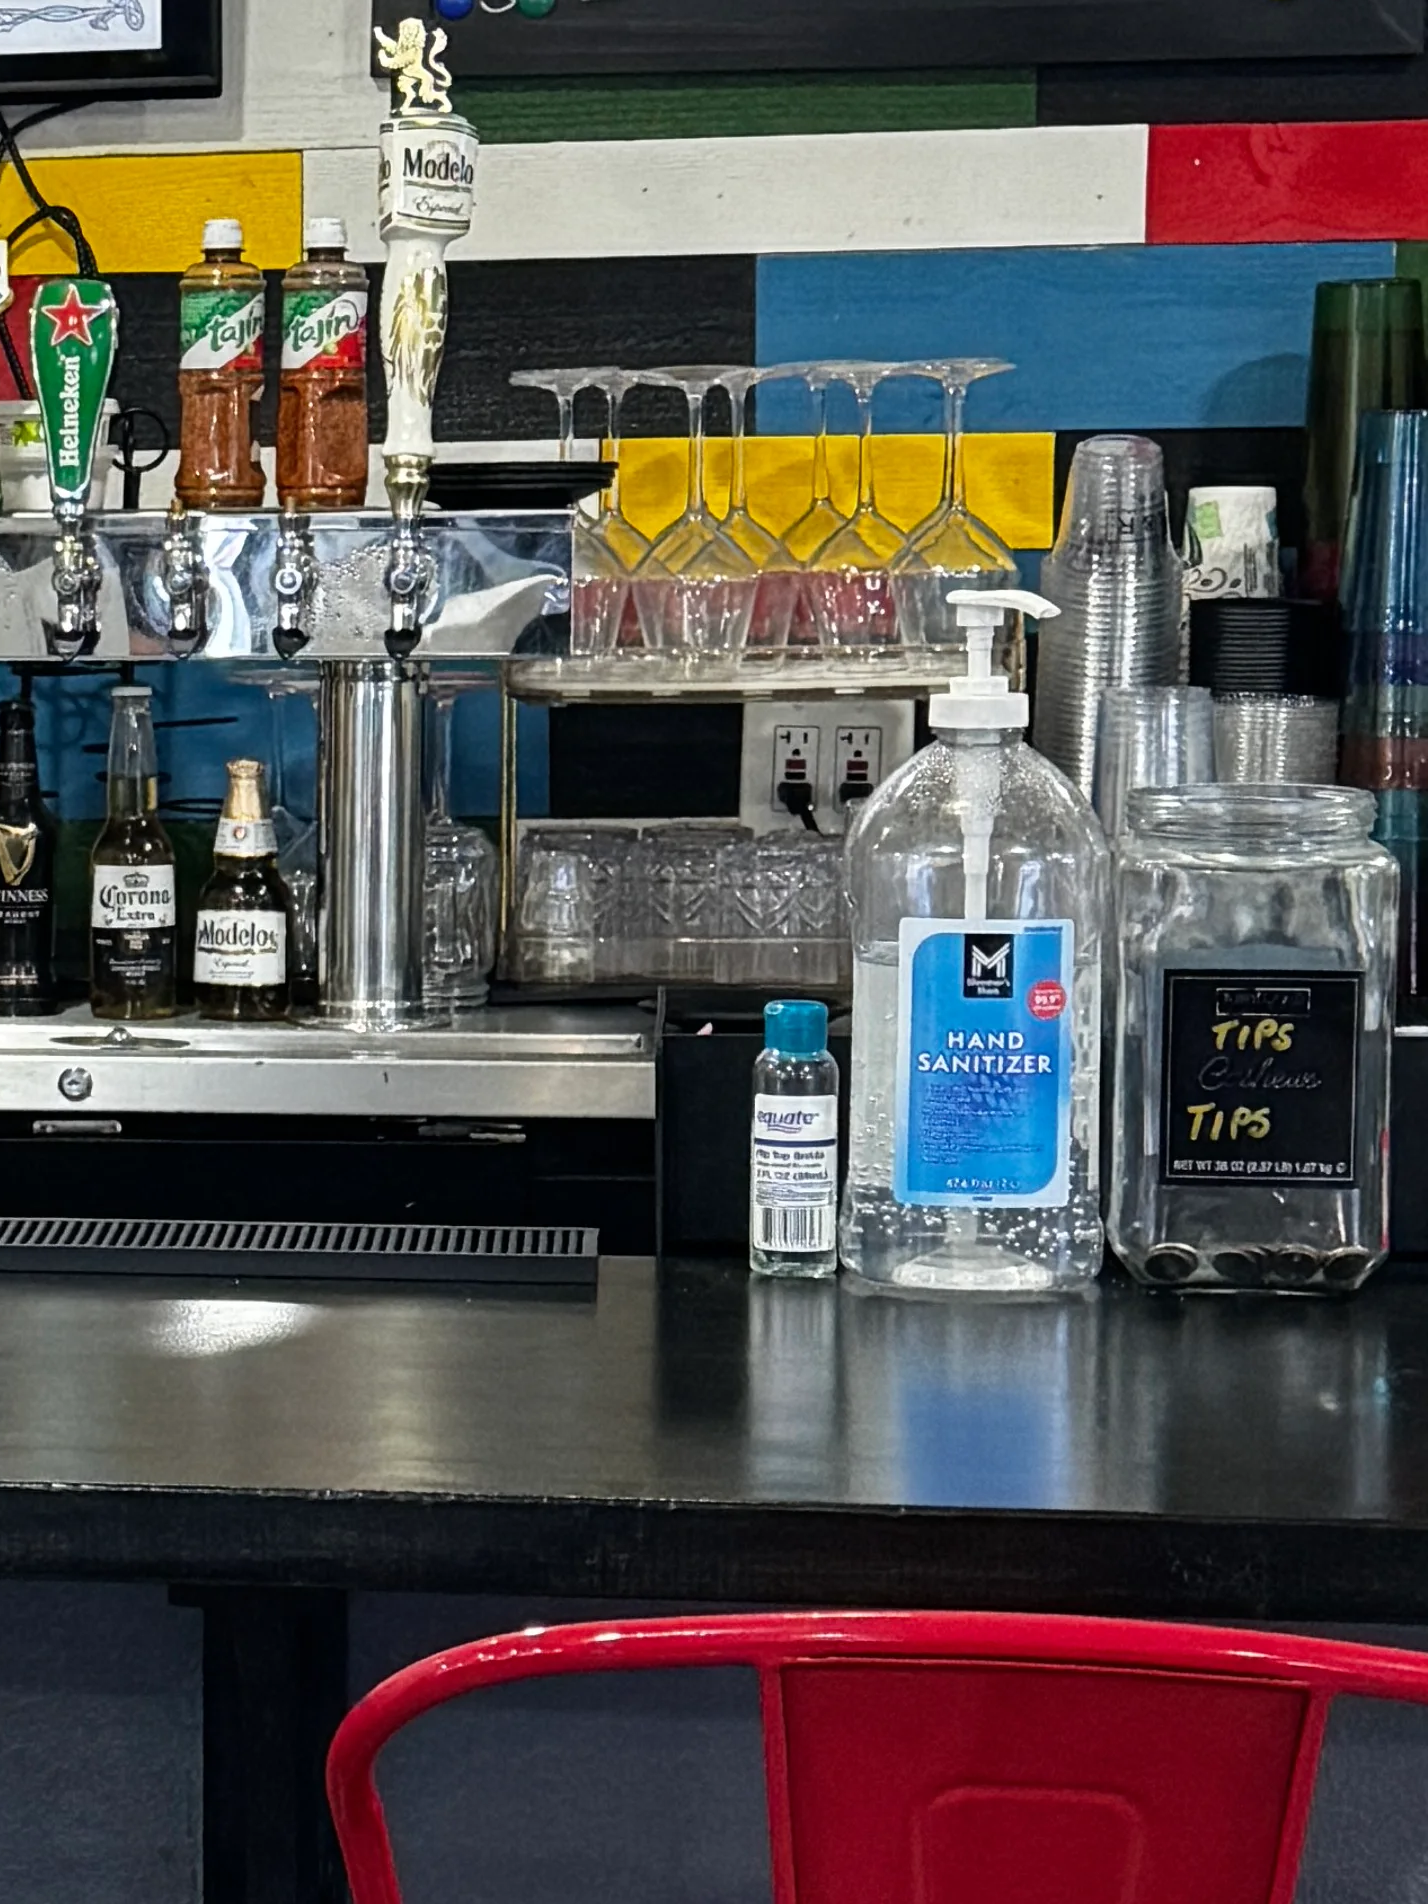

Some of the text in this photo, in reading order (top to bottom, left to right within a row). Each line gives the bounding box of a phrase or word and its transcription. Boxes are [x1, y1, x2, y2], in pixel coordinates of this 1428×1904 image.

[403, 147, 474, 184] Modelo
[59, 352, 81, 467] Heineken
[99, 884, 171, 914] Corona
[115, 911, 156, 922] Extra
[948, 1031, 1024, 1049] HAND
[1212, 1018, 1294, 1051] TIPS
[917, 1052, 1053, 1074] SANITIZER
[757, 1110, 814, 1129] equate
[1187, 1102, 1271, 1141] TIPS
